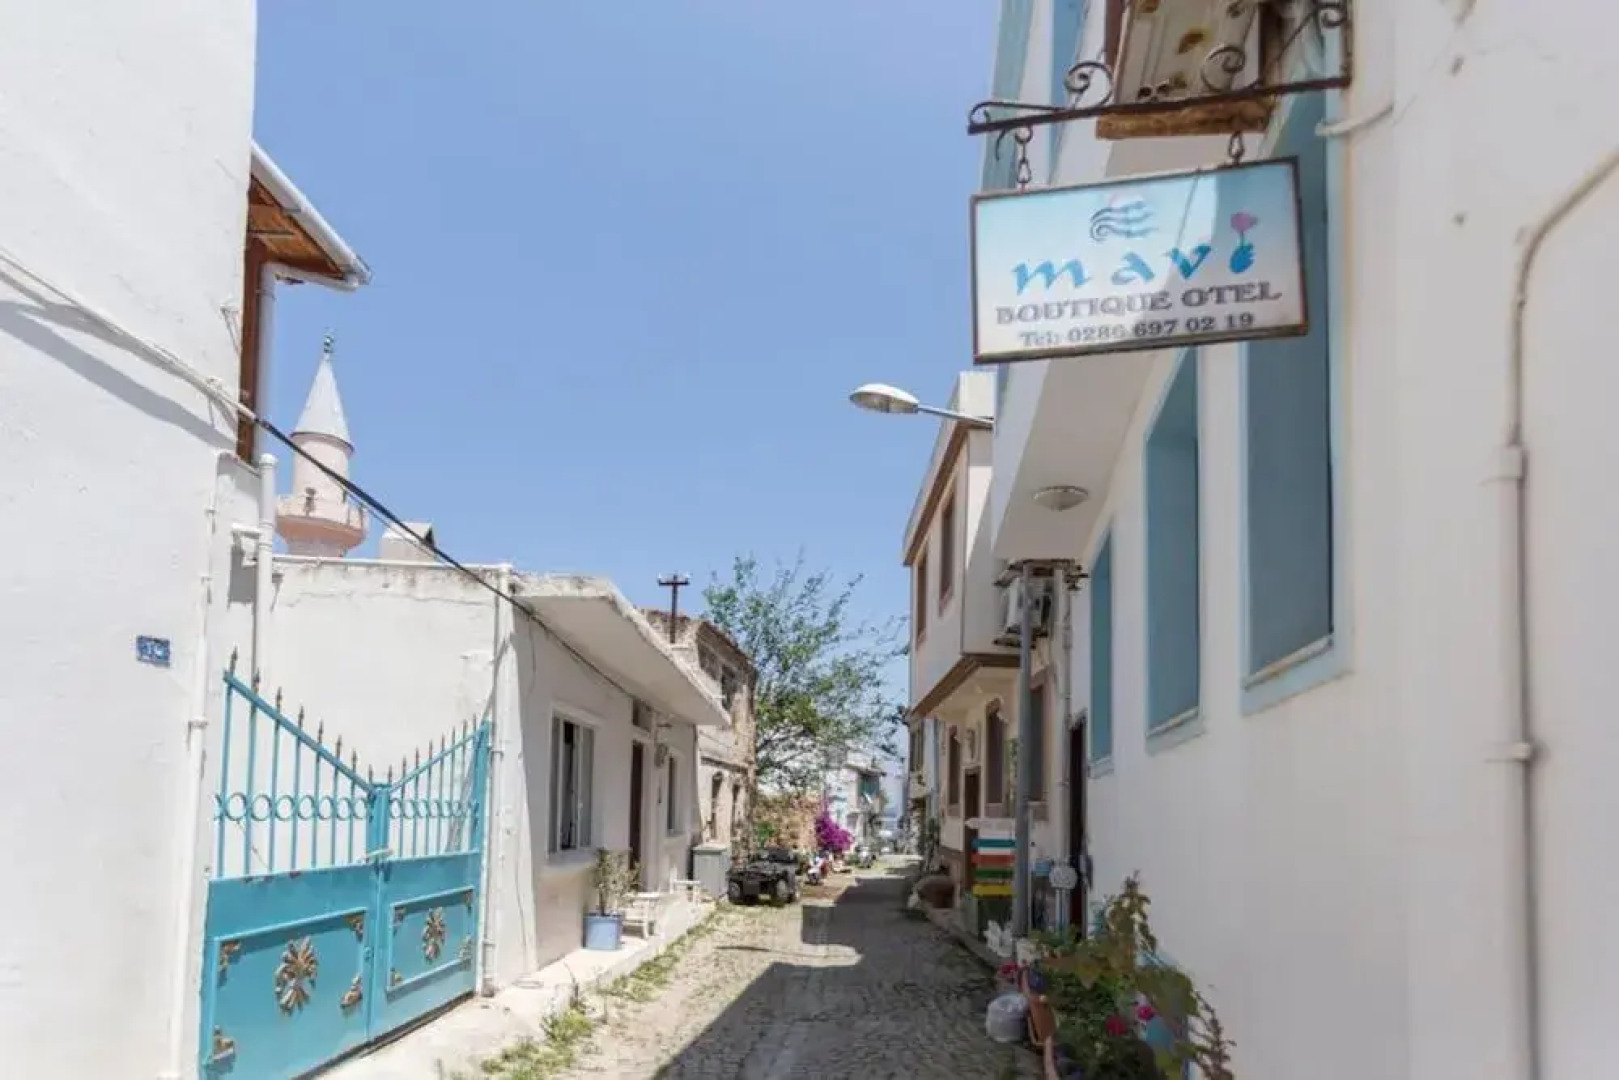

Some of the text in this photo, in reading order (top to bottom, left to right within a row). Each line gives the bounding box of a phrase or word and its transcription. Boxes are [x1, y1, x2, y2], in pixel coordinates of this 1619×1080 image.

[996, 281, 1282, 325] BOUTIQUE OTEL
[1132, 316, 1178, 337] 697
[1185, 315, 1215, 332] 02
[1225, 312, 1255, 330] 19
